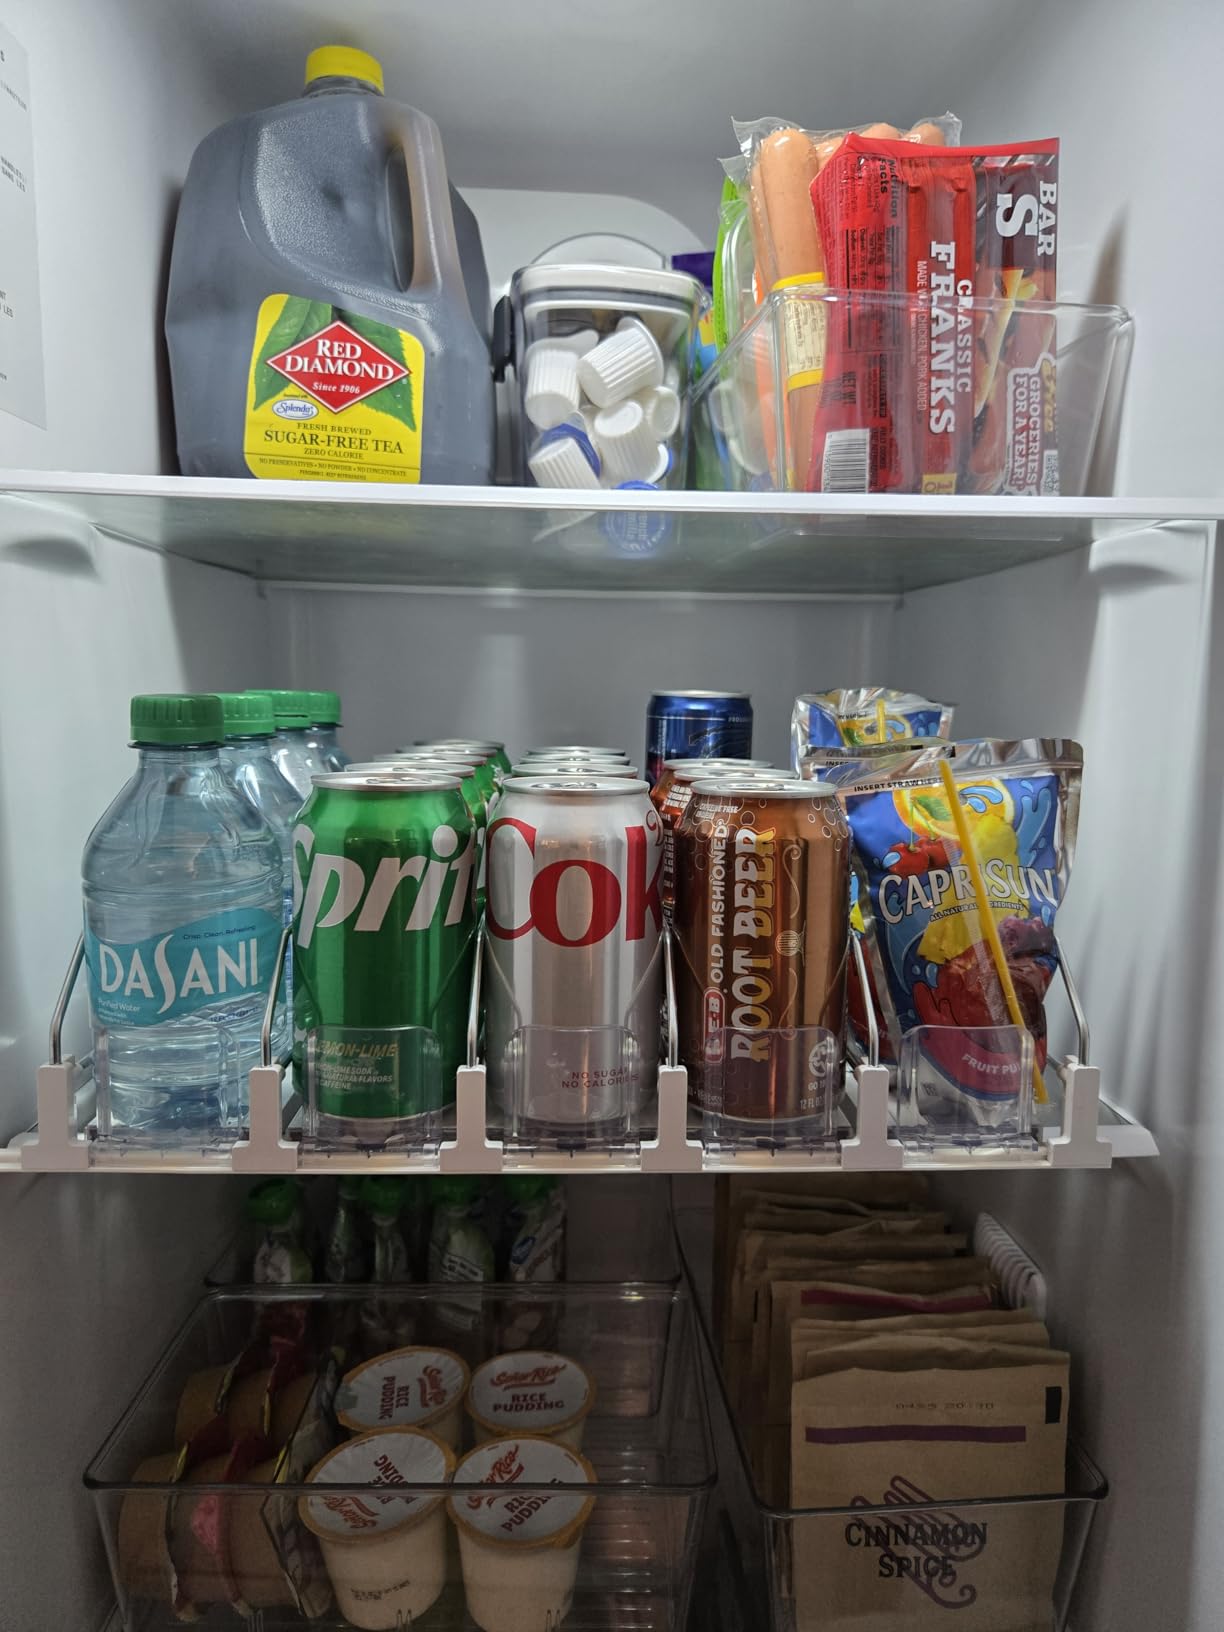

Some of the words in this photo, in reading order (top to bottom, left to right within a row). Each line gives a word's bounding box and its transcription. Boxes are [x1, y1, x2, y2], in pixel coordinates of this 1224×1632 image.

[880, 158, 889, 194] Facts
[889, 159, 898, 218] Nutrition
[996, 193, 1039, 237] S
[1037, 181, 1057, 256] BAR
[917, 261, 928, 287] MADE
[930, 241, 956, 434] FRANKS
[956, 279, 974, 393] CLASSIC
[317, 339, 362, 359] RED
[285, 355, 394, 381] DIAMOND
[917, 357, 928, 380] PORK
[312, 381, 337, 392] Since
[339, 384, 360, 394] 1906
[917, 381, 928, 411] ADDED
[1015, 376, 1028, 412] FOR
[276, 402, 314, 416] Splenda
[297, 423, 328, 432] FRESH
[331, 426, 372, 436] BREWED
[1015, 417, 1028, 429] A
[1026, 376, 1041, 484] GROCERIES
[264, 430, 369, 451] SUGAR-FREE
[371, 439, 404, 454] TEA
[304, 448, 326, 456] ZERO
[327, 450, 364, 460] CALORIE
[268, 458, 314, 469] PRESERVATIVES
[327, 463, 353, 472] POWDER
[1011, 432, 1027, 485] YEAR!
[854, 782, 885, 792] INSERT
[887, 779, 918, 788] STRAW
[292, 823, 477, 950] Sprit
[485, 809, 665, 948] Cok
[711, 825, 728, 937] FASHIONED
[733, 827, 776, 938] BEER
[930, 912, 943, 922] ALL
[944, 903, 979, 917] NATURAL
[100, 934, 258, 1014] DASANI
[711, 943, 724, 983] OLD
[119, 1003, 141, 1013] Water
[731, 947, 774, 1062] ROOT
[572, 1071, 590, 1080] NO
[961, 1053, 999, 1075] FRUIT
[359, 1075, 393, 1083] FLAVORS
[561, 1080, 579, 1089] NO
[808, 1081, 818, 1091] GO
[800, 1099, 807, 1110] 12
[379, 1375, 396, 1420] PUDDING
[396, 1385, 410, 1409] RICE
[493, 1400, 565, 1413] PUDDING
[511, 1392, 546, 1402] RICE
[845, 1521, 988, 1548] CINNAMON
[878, 1553, 954, 1578] SPICE
